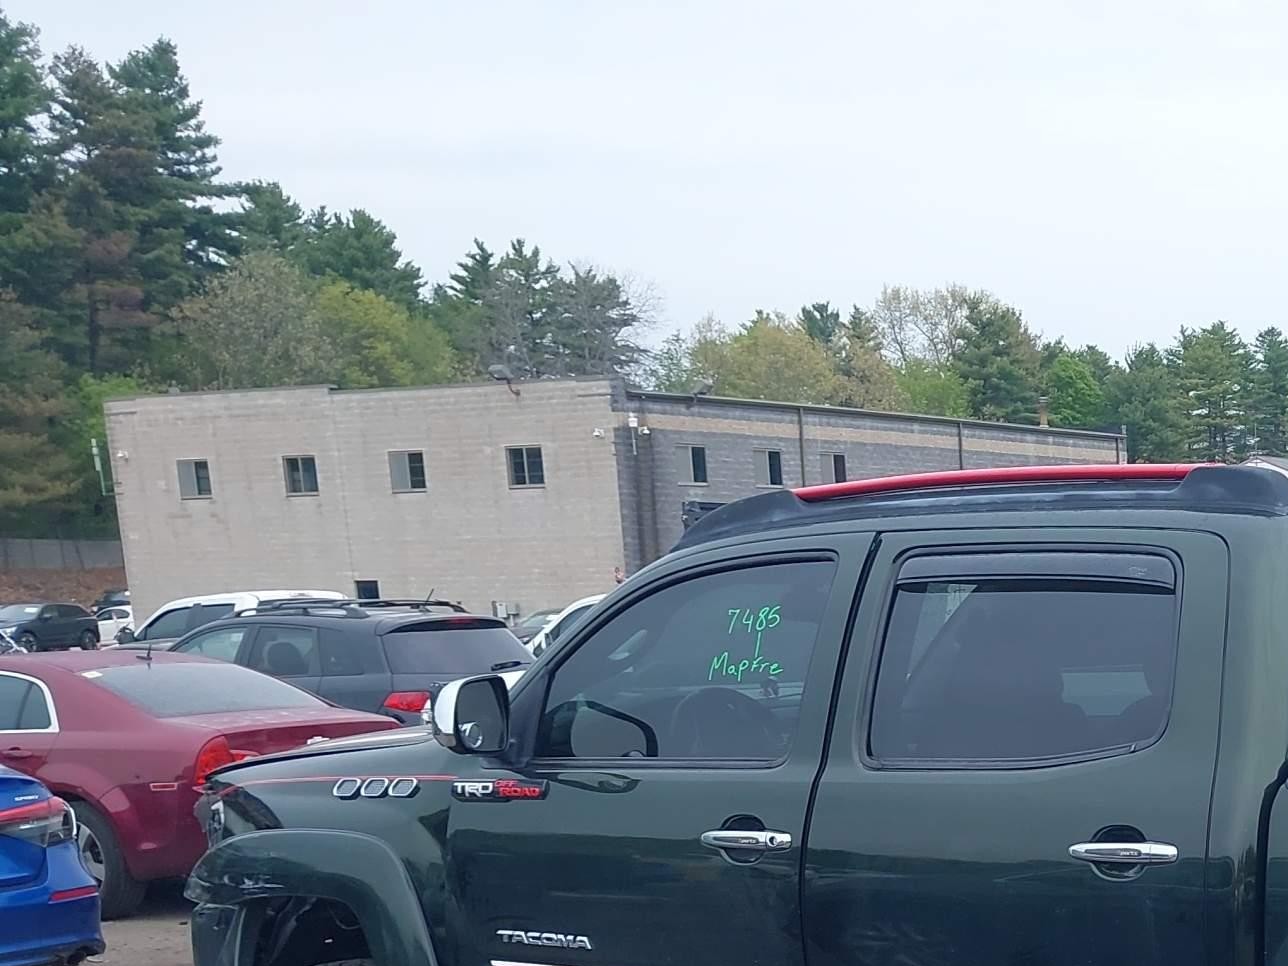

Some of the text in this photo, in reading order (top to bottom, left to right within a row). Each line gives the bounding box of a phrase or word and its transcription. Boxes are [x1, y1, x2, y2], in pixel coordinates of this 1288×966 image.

[728, 605, 781, 634] 7485
[453, 782, 493, 797] TRD
[500, 787, 541, 798] ROAD
[496, 929, 592, 949] TACOMA
